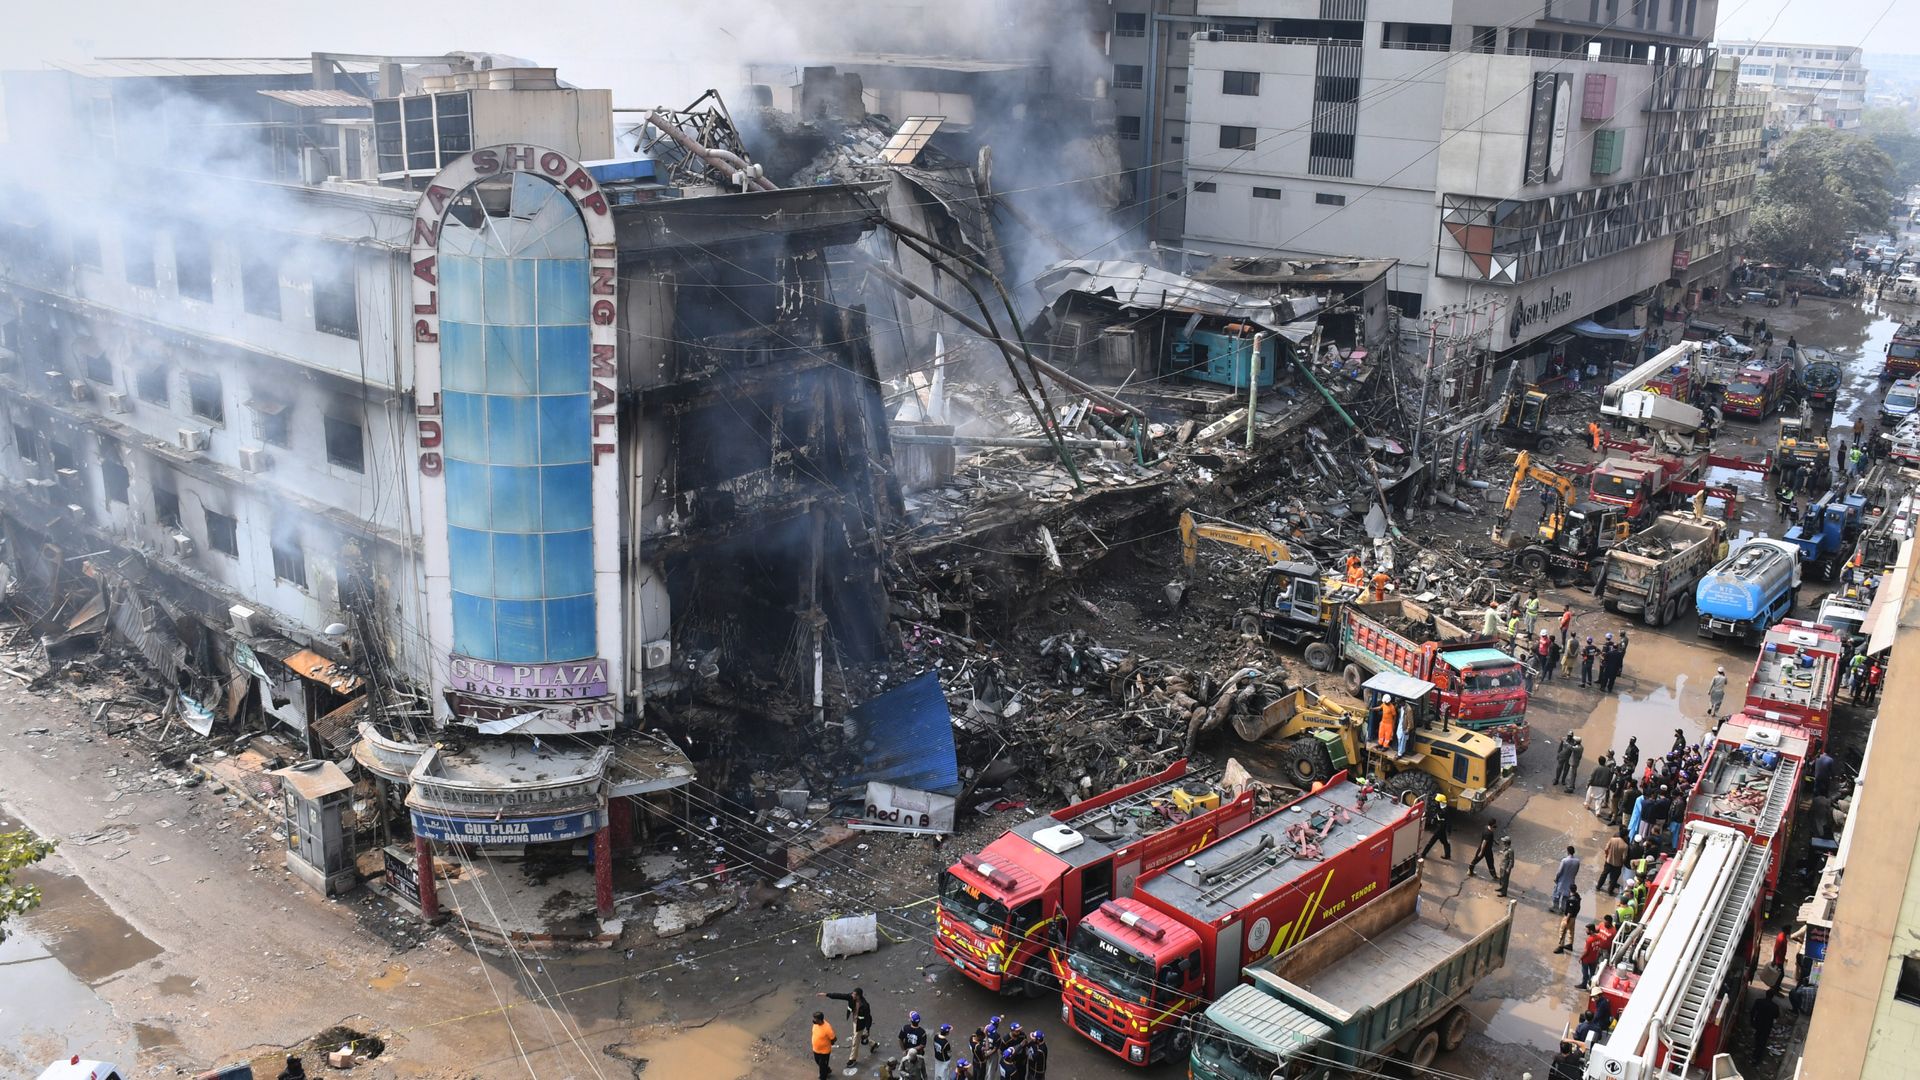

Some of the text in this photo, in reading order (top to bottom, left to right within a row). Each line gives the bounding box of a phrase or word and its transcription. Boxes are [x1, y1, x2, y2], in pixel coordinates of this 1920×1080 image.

[413, 185, 455, 478] GUL PLAZA
[591, 344, 616, 467] MALL
[1209, 531, 1239, 541] HYUNDAI
[451, 658, 607, 686] GUL PLAZA
[466, 681, 591, 698] BASEMENT
[464, 823, 530, 834] GUL PLAZA
[484, 832, 529, 843] SHOPPING
[531, 831, 553, 841] MALL
[1322, 881, 1377, 919] WATER TENDER
[1099, 940, 1119, 956] KMC
